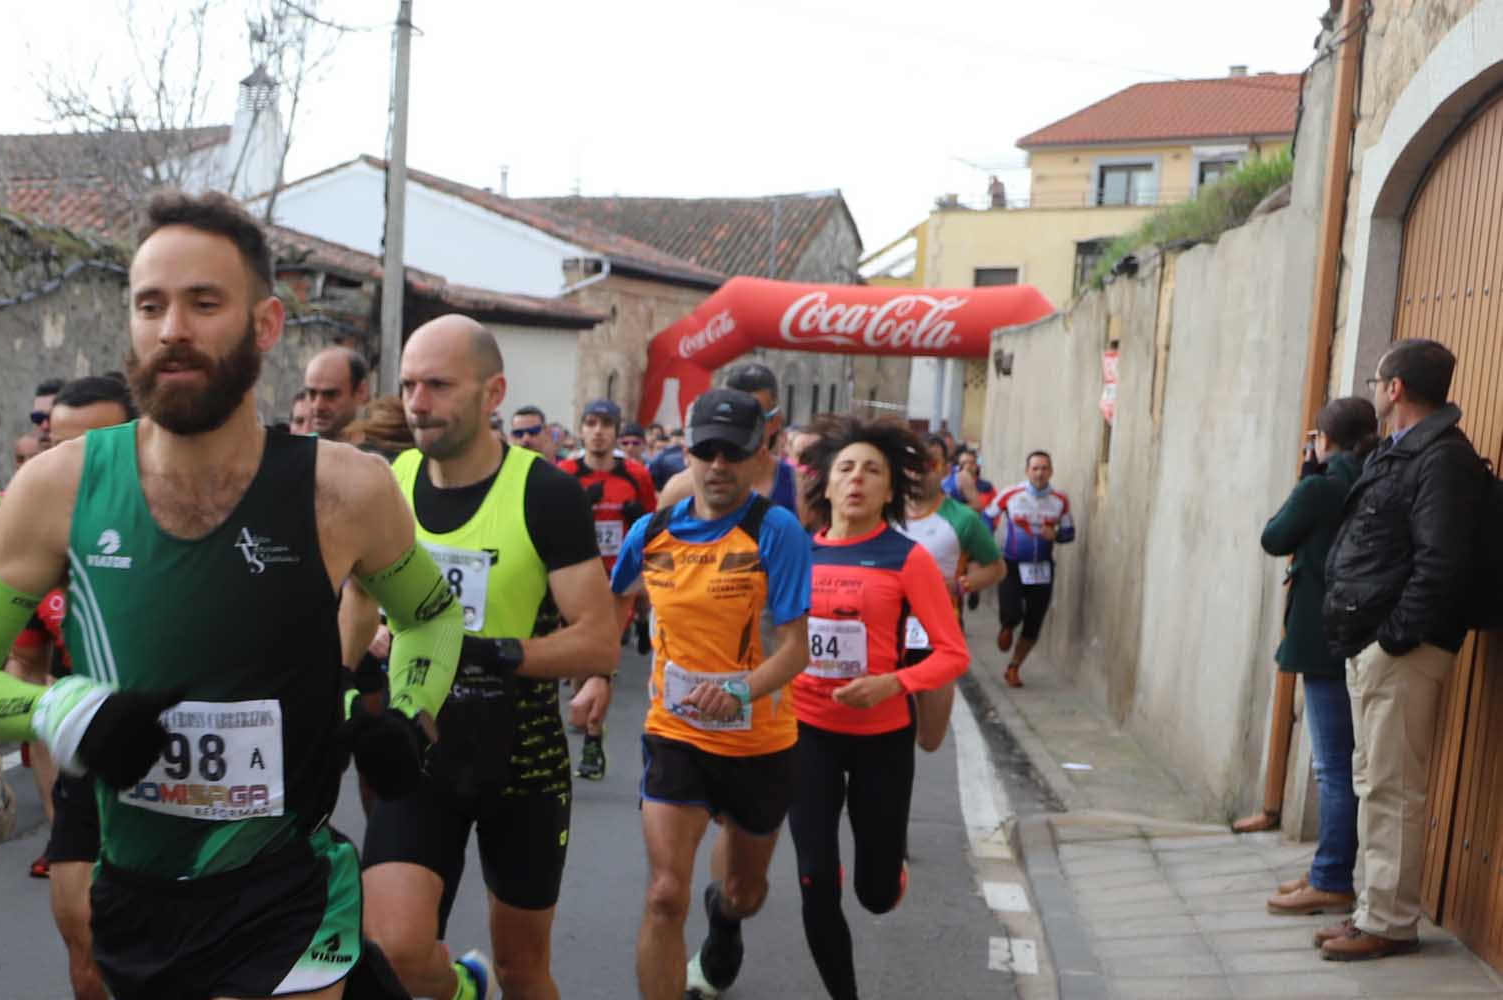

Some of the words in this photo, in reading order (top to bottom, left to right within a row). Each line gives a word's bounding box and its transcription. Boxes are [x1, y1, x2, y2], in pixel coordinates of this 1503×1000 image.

[780, 291, 969, 348] Coca-Cola
[164, 732, 227, 782] 98
[249, 747, 266, 770] A
